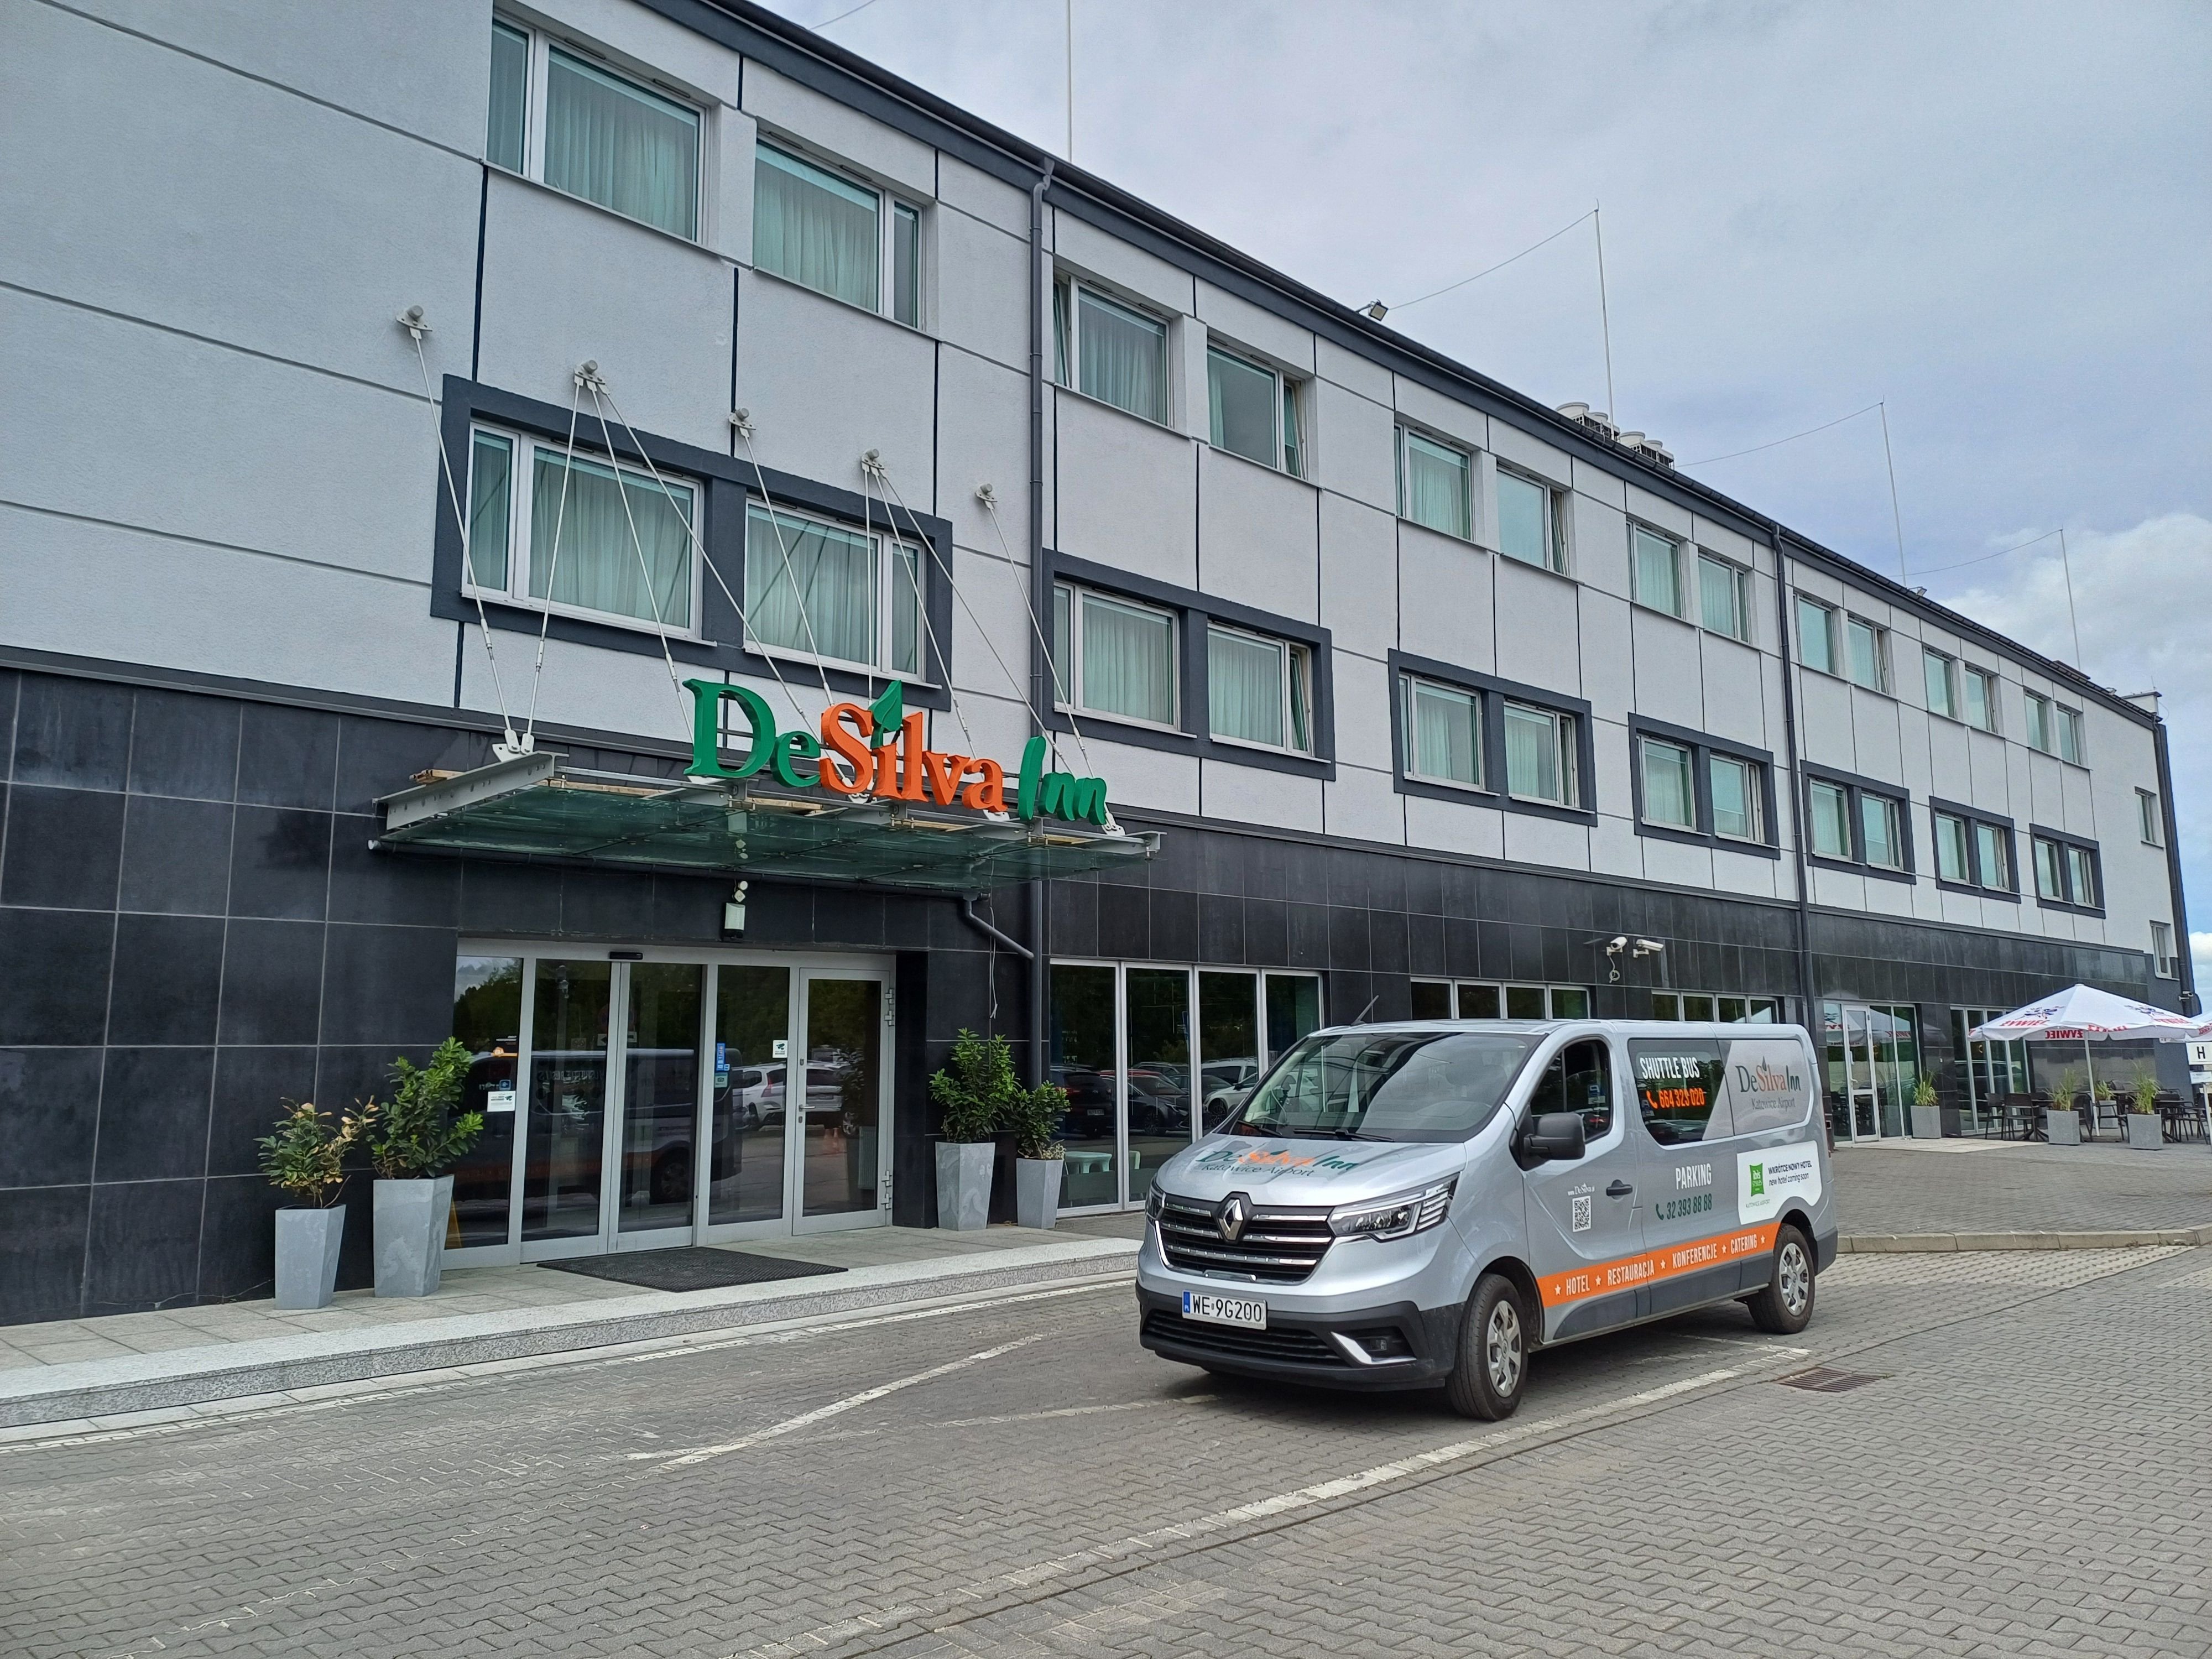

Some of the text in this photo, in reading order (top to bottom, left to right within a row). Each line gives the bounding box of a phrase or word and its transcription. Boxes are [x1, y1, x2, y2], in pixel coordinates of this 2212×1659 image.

[682, 679, 1107, 825] DeSilva Inn
[2197, 1046, 2206, 1059] H
[1640, 1057, 1700, 1079] SHUTTLE BUS
[1786, 1065, 1801, 1092] Inn
[1658, 1089, 1675, 1108] 664
[1689, 1087, 1705, 1106] 020
[1777, 1097, 1796, 1112] Airport
[1201, 1164, 1315, 1177] Katowice Airport
[1312, 1155, 1360, 1171] Inn
[1800, 1160, 1812, 1168] HOTEL
[1675, 1163, 1712, 1190] PARKING
[1667, 1193, 1712, 1220] 32 393 88 88
[1566, 1234, 1757, 1296] HOTEL RESTAURACJA KONFERENCJE CATERING
[1192, 1295, 1210, 1316] WE
[1215, 1299, 1262, 1322] 9G200
